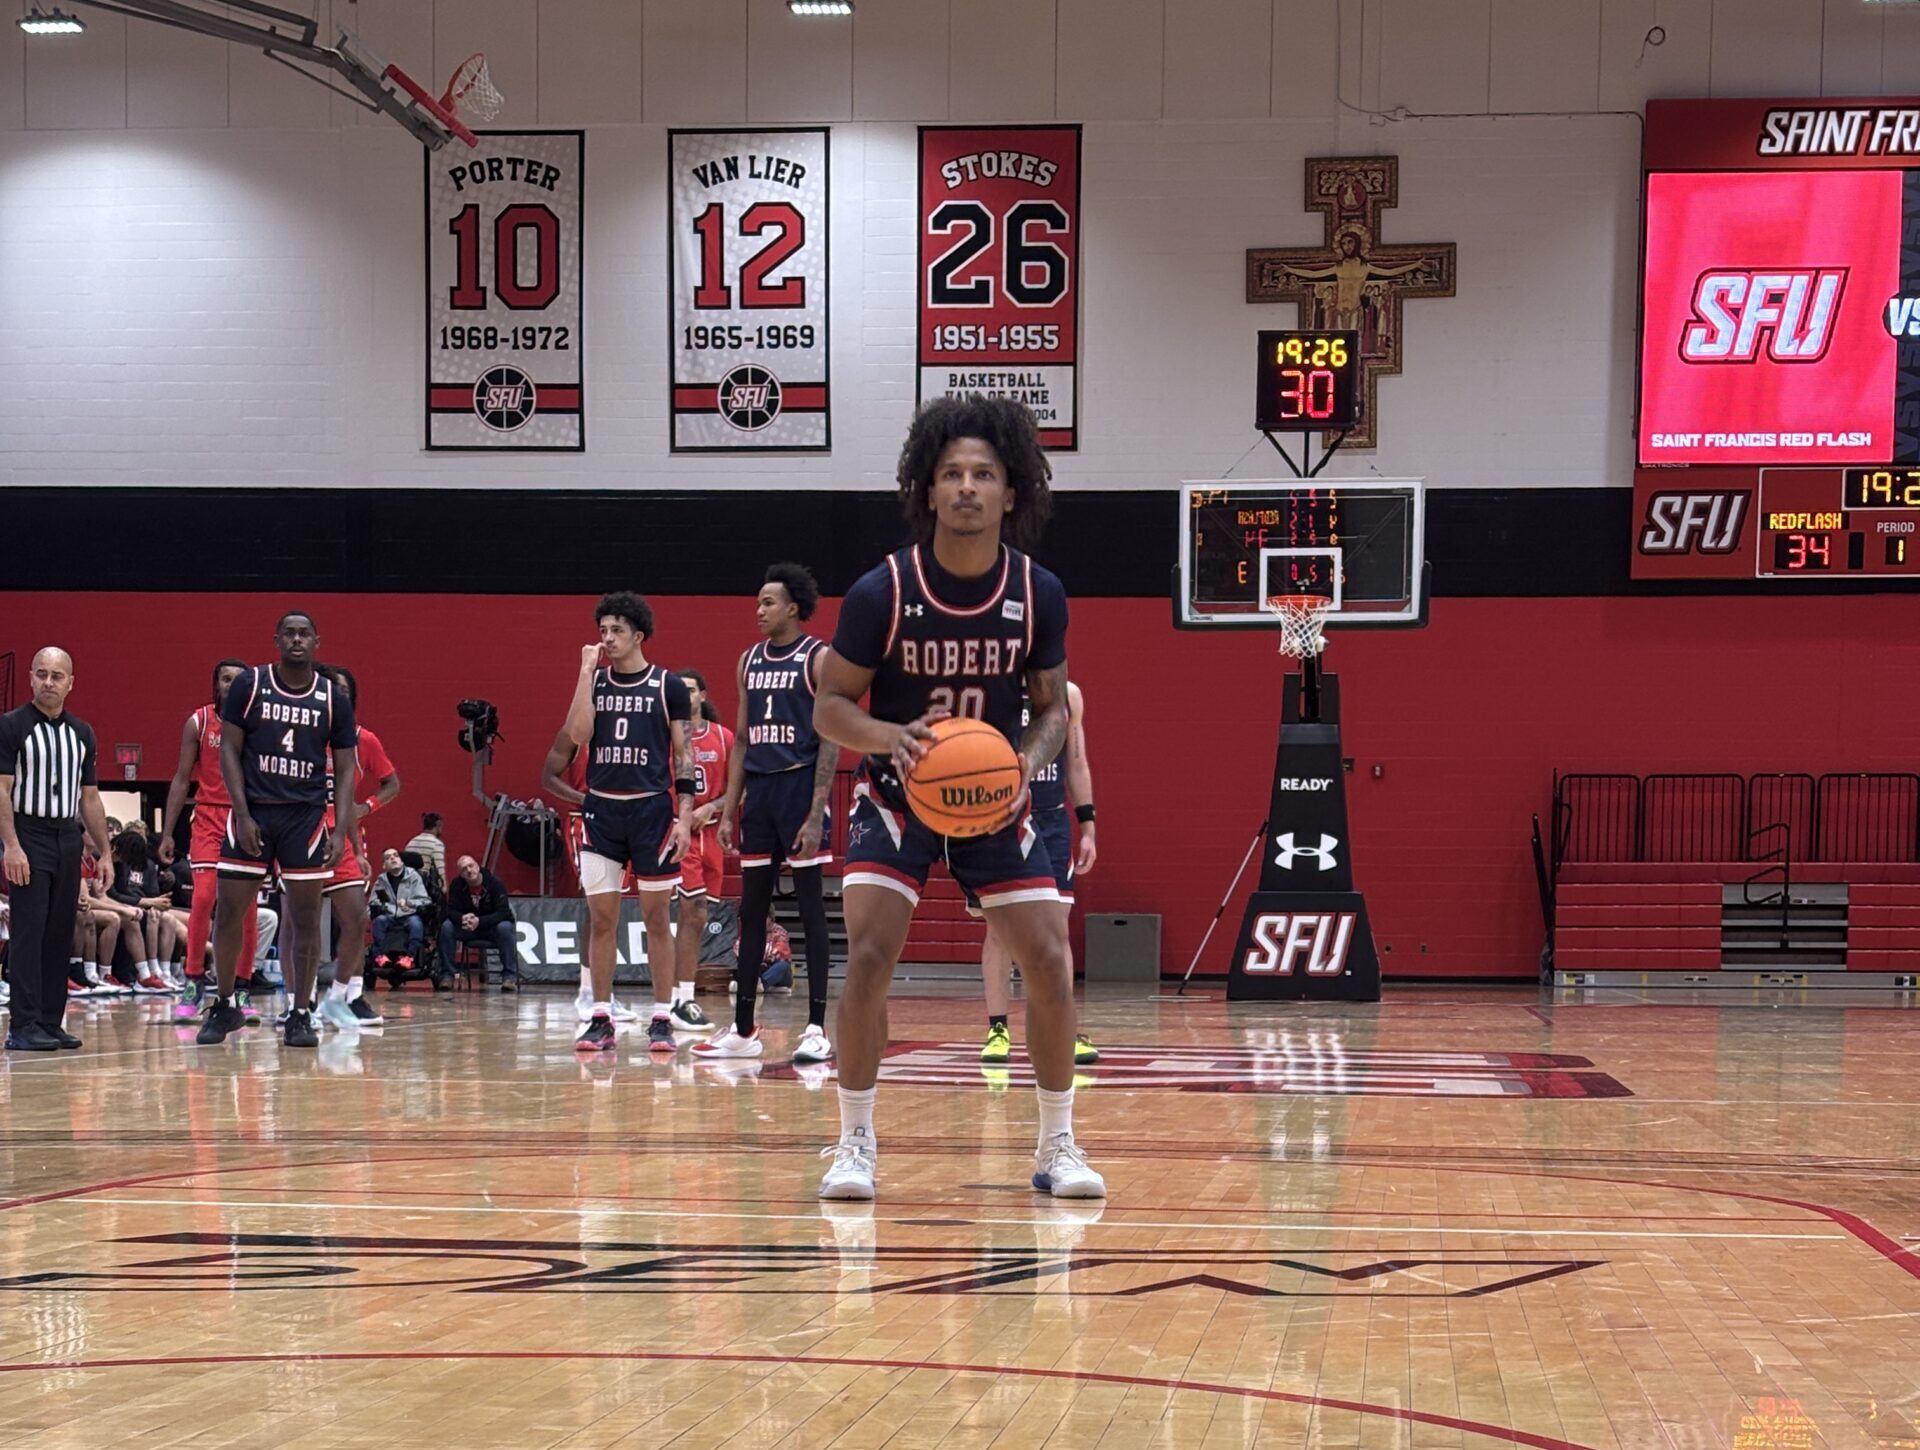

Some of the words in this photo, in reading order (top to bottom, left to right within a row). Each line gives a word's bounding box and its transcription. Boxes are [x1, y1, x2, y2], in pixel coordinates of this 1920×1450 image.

[1759, 110, 1871, 154] SAINT
[1868, 109, 1920, 153] FR
[448, 157, 562, 192] PORTER
[692, 155, 740, 189] VAN
[748, 155, 807, 190] LIER
[941, 151, 1058, 189] STOKES
[448, 203, 561, 310] 10
[692, 202, 806, 310] 12
[927, 199, 1071, 308] 26
[1684, 272, 1842, 358] SFU
[440, 326, 570, 350] 1968-1972
[684, 325, 815, 350] 1965-1969
[932, 324, 1061, 351] 1951-1955
[1277, 338, 1348, 367] 19:26
[948, 373, 1046, 388] BASKETBALL
[486, 387, 523, 409] SFU
[731, 386, 768, 408] SFU
[1280, 370, 1335, 418] 30
[1651, 434, 1702, 448] SAINT
[1704, 433, 1777, 447] FRANCIS
[1779, 433, 1815, 447] RED
[1817, 432, 1872, 447] FLASH
[1643, 494, 1745, 550] SFU
[1876, 521, 1915, 533] PERIOD
[1788, 534, 1829, 568] 34
[1898, 539, 1904, 562] 1
[902, 638, 1022, 677] ROBERT
[747, 671, 798, 690] ROBERT
[261, 701, 322, 727] ROBERT
[596, 695, 654, 713] ROBERT
[764, 695, 773, 719] 1
[281, 729, 295, 752] 4
[615, 717, 628, 740] 0
[749, 724, 795, 745] MORRIS
[259, 754, 314, 779] MORRIS
[595, 746, 649, 766] MORRIS
[941, 784, 1013, 807] Wilson
[1245, 914, 1353, 972] SFU
